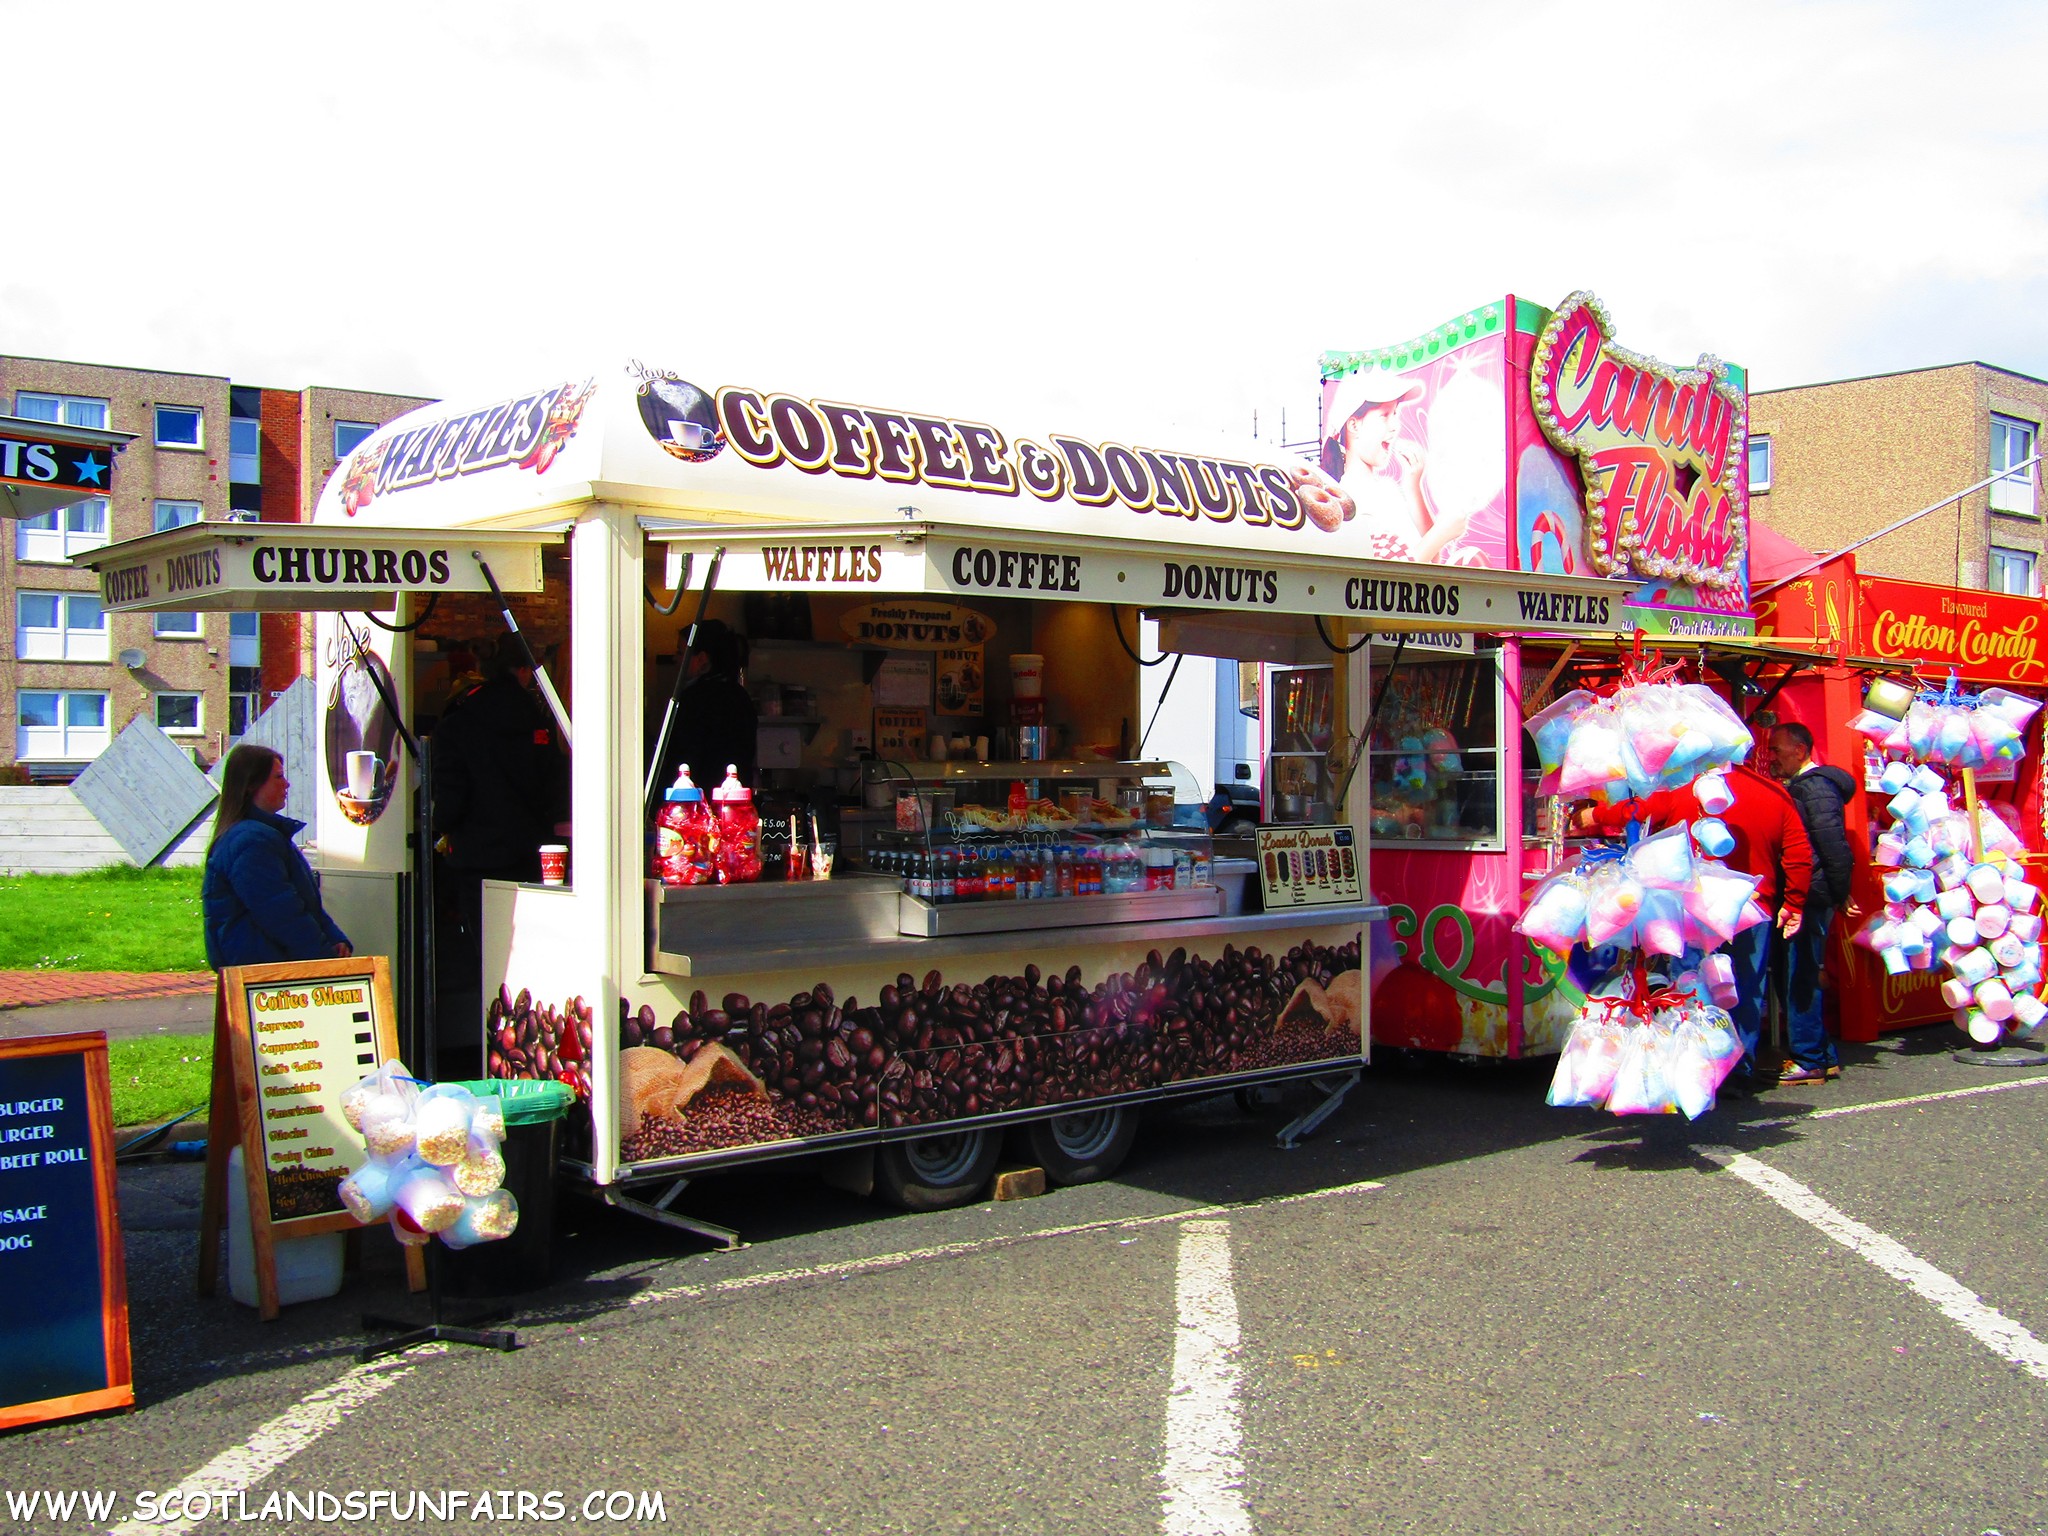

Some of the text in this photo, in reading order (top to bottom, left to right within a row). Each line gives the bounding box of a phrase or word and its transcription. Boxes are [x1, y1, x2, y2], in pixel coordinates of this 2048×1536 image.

[1545, 303, 1734, 487] Candy
[373, 382, 568, 498] WAFFLES
[715, 385, 1306, 531] COFFEE & DONUTS
[1590, 446, 1735, 570] Floss
[105, 548, 221, 604] COFFEE DONUTS
[253, 546, 450, 584] CHURROS
[762, 545, 883, 583] WAFFLES
[952, 547, 1610, 625] COFFEE DONUTS CHURROS WAFFLES
[871, 607, 952, 622] Freshly Prepared
[1941, 597, 1988, 618] Flavoured
[858, 622, 962, 642] DONUTS
[1872, 609, 2045, 680] Cotton Candy
[1261, 832, 1298, 850] Loaded
[1298, 830, 1333, 848] Donuts
[255, 985, 364, 1012] Coffee Menu
[257, 1020, 305, 1034] Espresso
[259, 1039, 320, 1056] Cappuccino
[266, 1105, 325, 1120] Americano
[268, 1127, 309, 1142] Mocha
[1, 1147, 88, 1171] BEEF ROLL
[304, 1146, 335, 1160] Chino
